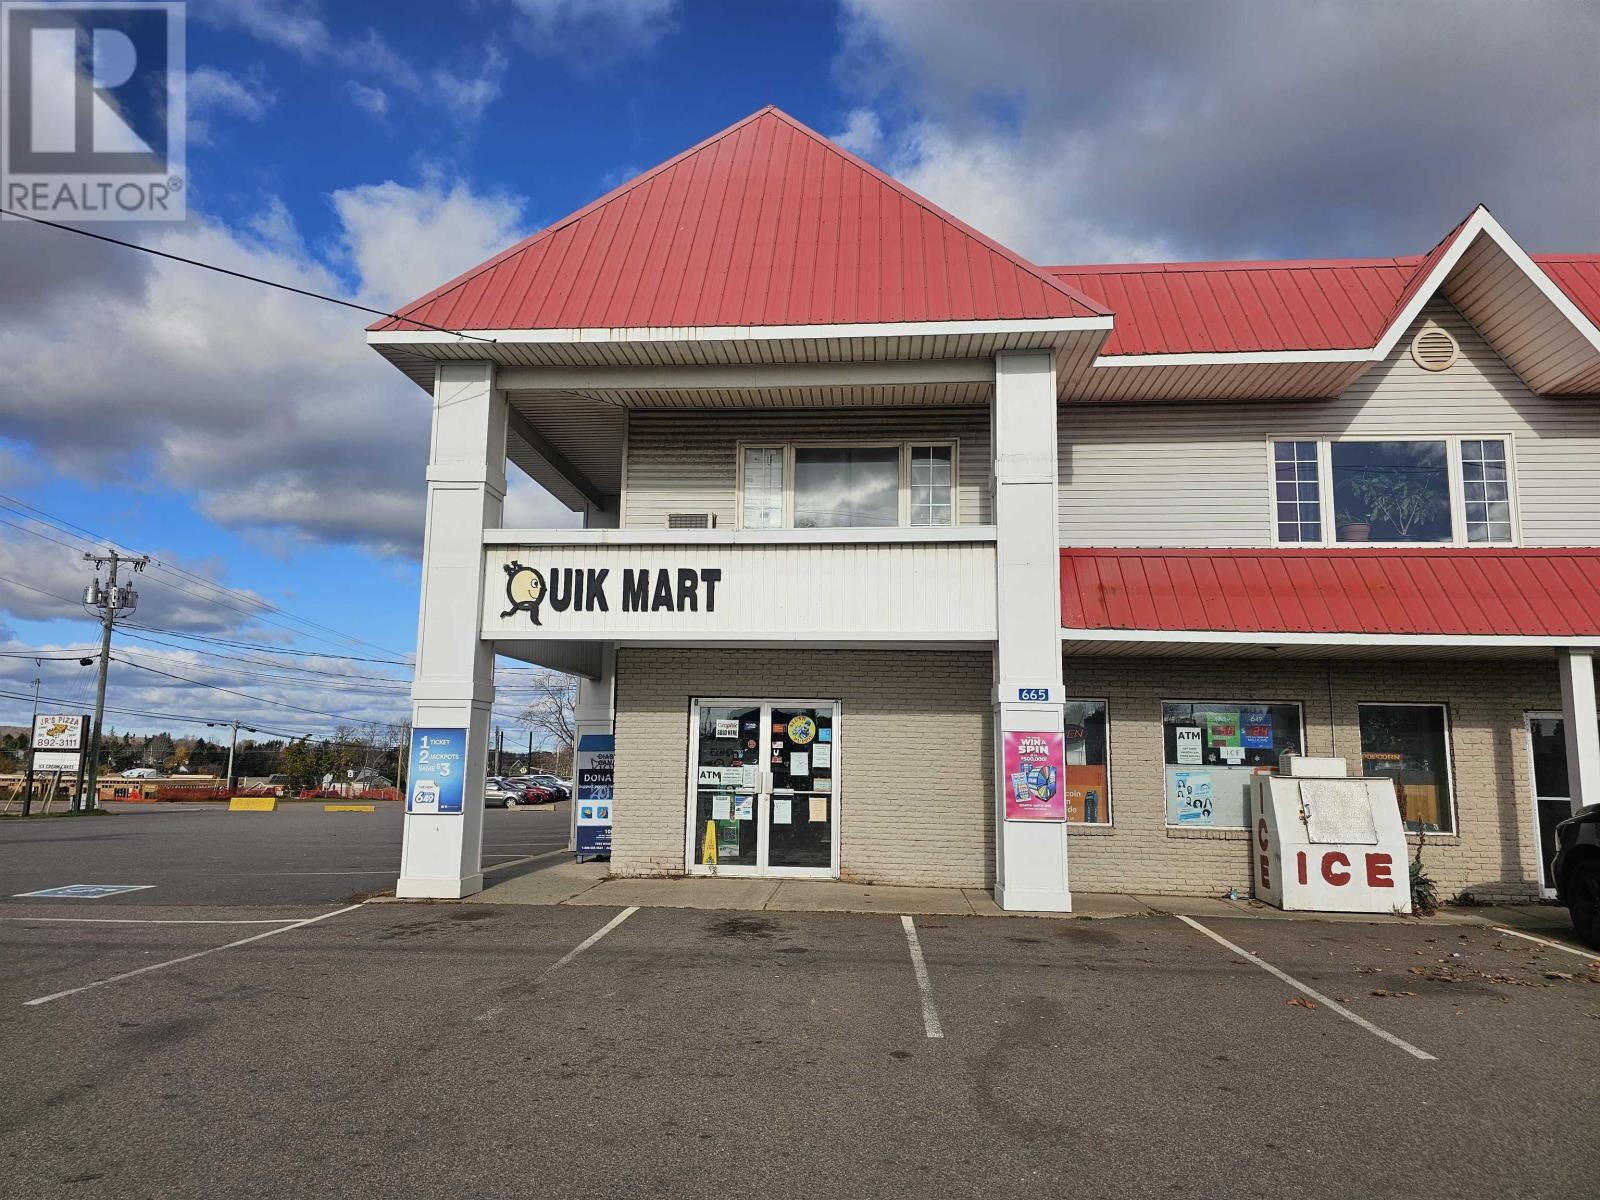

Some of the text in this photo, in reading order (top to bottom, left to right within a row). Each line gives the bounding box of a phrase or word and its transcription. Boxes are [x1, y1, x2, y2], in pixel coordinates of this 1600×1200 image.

[500, 560, 722, 626] QUIK MART
[1021, 689, 1046, 700] 665
[58, 716, 79, 726] PIZZA
[1178, 732, 1201, 740] ATM
[37, 739, 77, 747] 892-3111
[420, 735, 430, 749] 1
[1021, 738, 1040, 746] WIN
[1018, 745, 1049, 755] SPIN
[418, 749, 429, 764] 2
[700, 771, 721, 780] ATM
[1258, 782, 1271, 890] ICE
[1297, 850, 1394, 888] ICE
